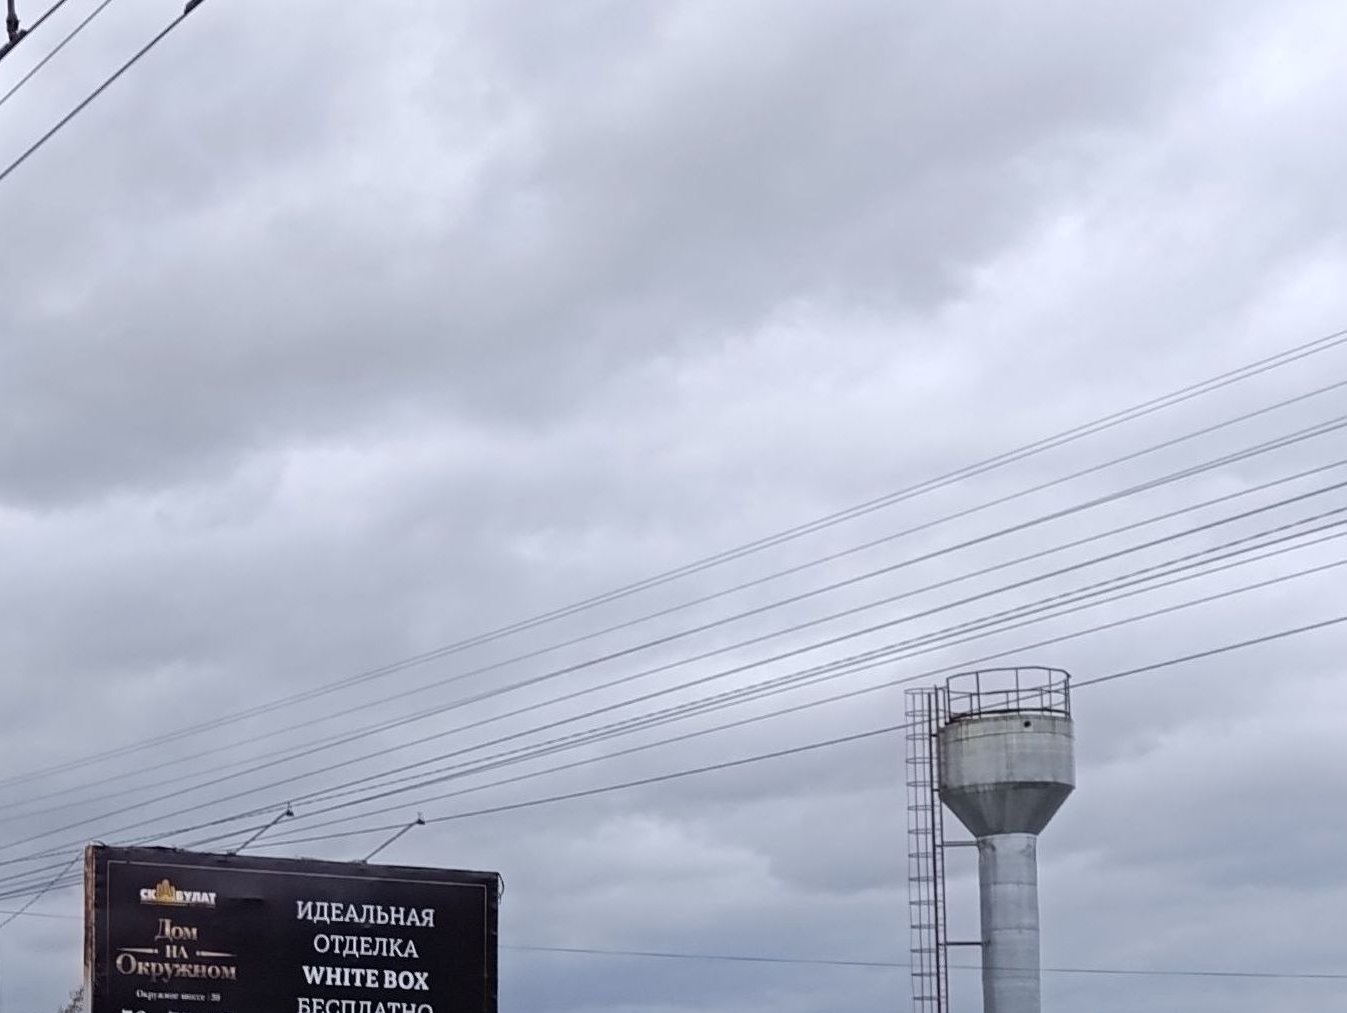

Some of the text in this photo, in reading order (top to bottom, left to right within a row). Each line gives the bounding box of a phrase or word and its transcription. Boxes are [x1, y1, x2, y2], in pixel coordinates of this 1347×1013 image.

[296, 900, 435, 928] ИДЕАЛЬНАЯ
[313, 933, 419, 958] ОТДЕЛКА
[302, 965, 429, 991] WHITE BOX
